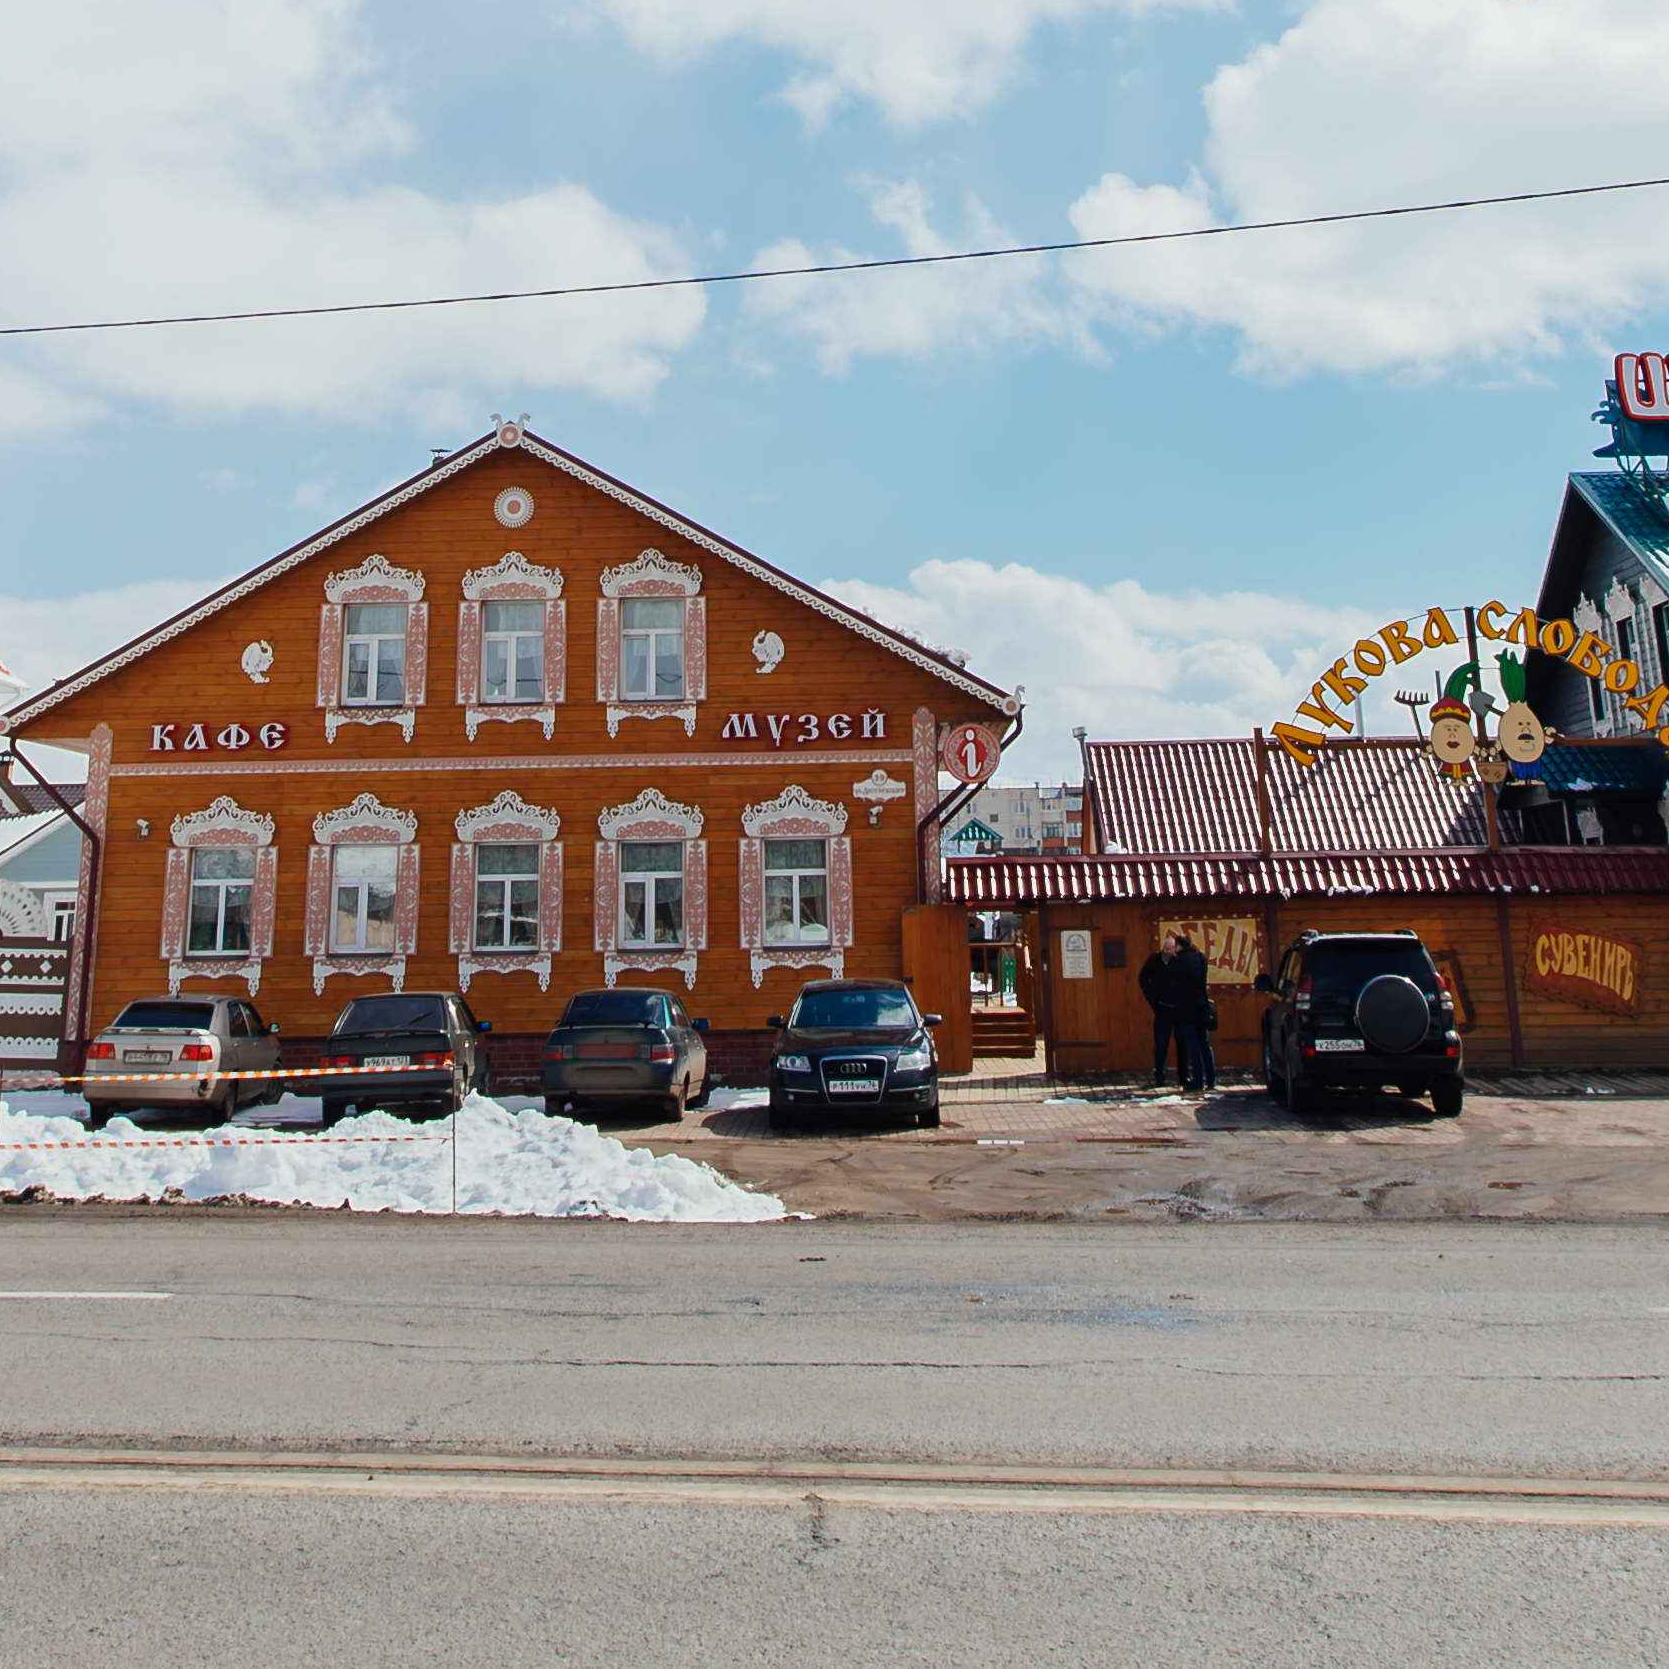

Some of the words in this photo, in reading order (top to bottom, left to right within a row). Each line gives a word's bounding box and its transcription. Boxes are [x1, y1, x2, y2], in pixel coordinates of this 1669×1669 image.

[1270, 606, 1460, 769] ЛУКОВА
[149, 722, 286, 751] КАФЕ
[722, 708, 887, 746] МУЗЕЙ
